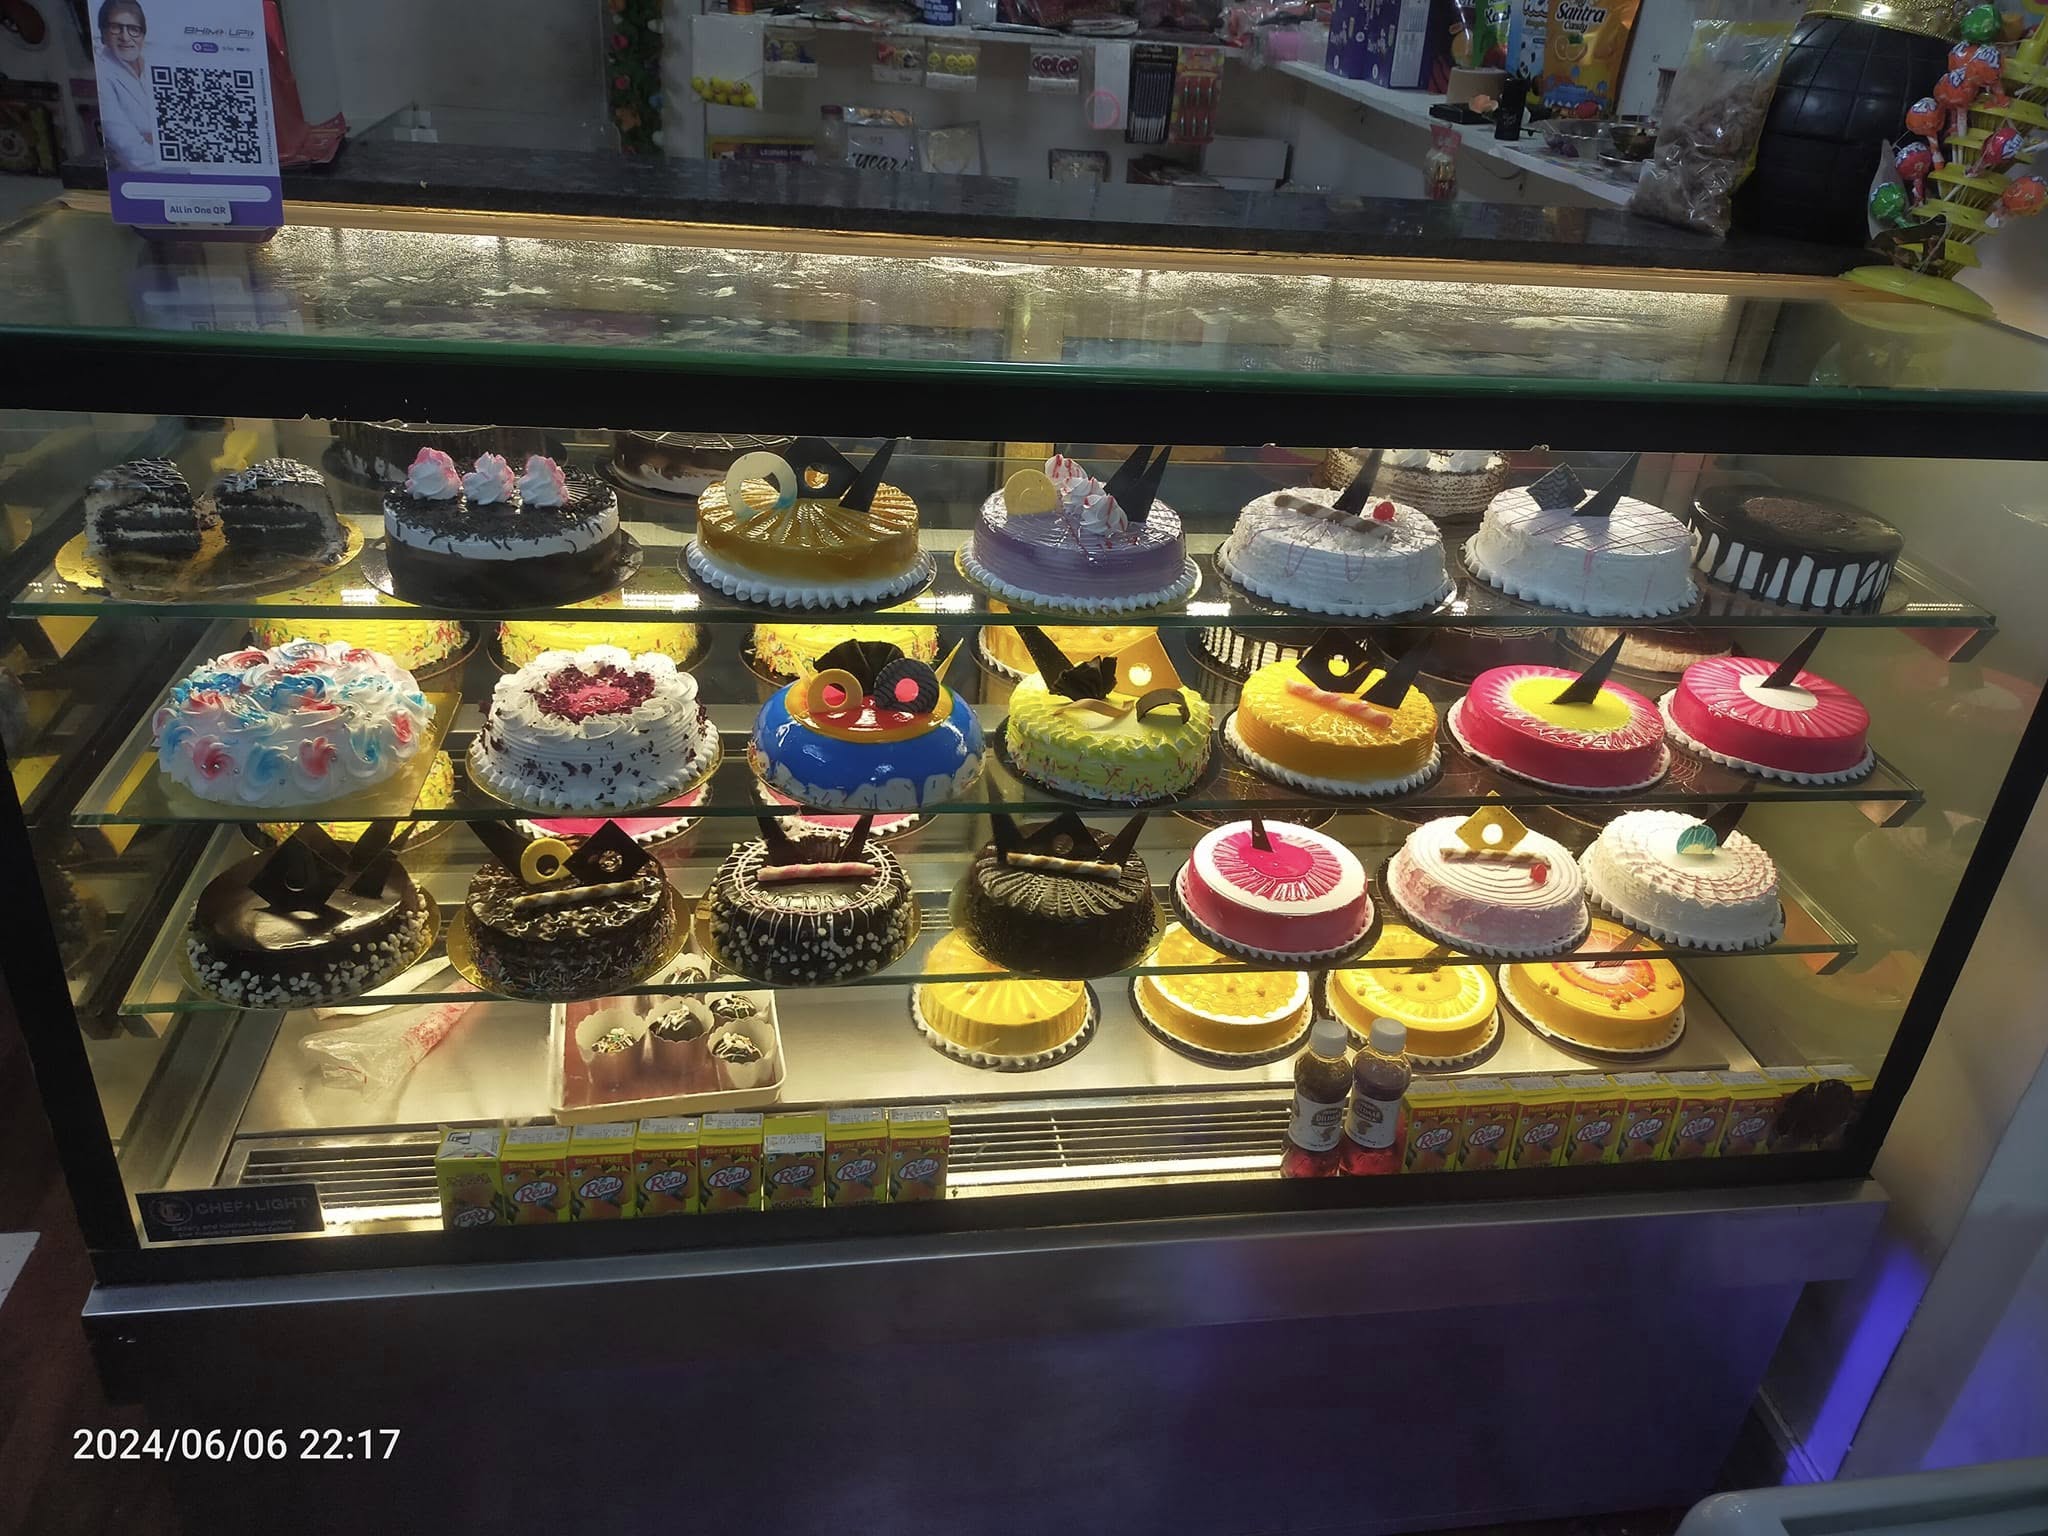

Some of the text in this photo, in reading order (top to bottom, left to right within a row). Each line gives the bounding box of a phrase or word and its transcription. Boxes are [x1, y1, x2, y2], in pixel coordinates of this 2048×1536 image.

[1557, 1, 1605, 23] Santra
[1565, 20, 1588, 33] Candy
[170, 205, 226, 215] All in One QR
[1474, 1127, 1502, 1144] Real
[1527, 1126, 1556, 1143] Real
[1580, 1122, 1609, 1140] Real
[1633, 1120, 1660, 1138] Real
[1420, 1131, 1449, 1149] Real
[715, 1169, 747, 1185] Real
[779, 1168, 811, 1183] Real
[842, 1163, 873, 1178] Real
[903, 1162, 935, 1178] Real
[585, 1180, 618, 1197] Real
[650, 1174, 683, 1191] Real
[520, 1185, 553, 1202] Real
